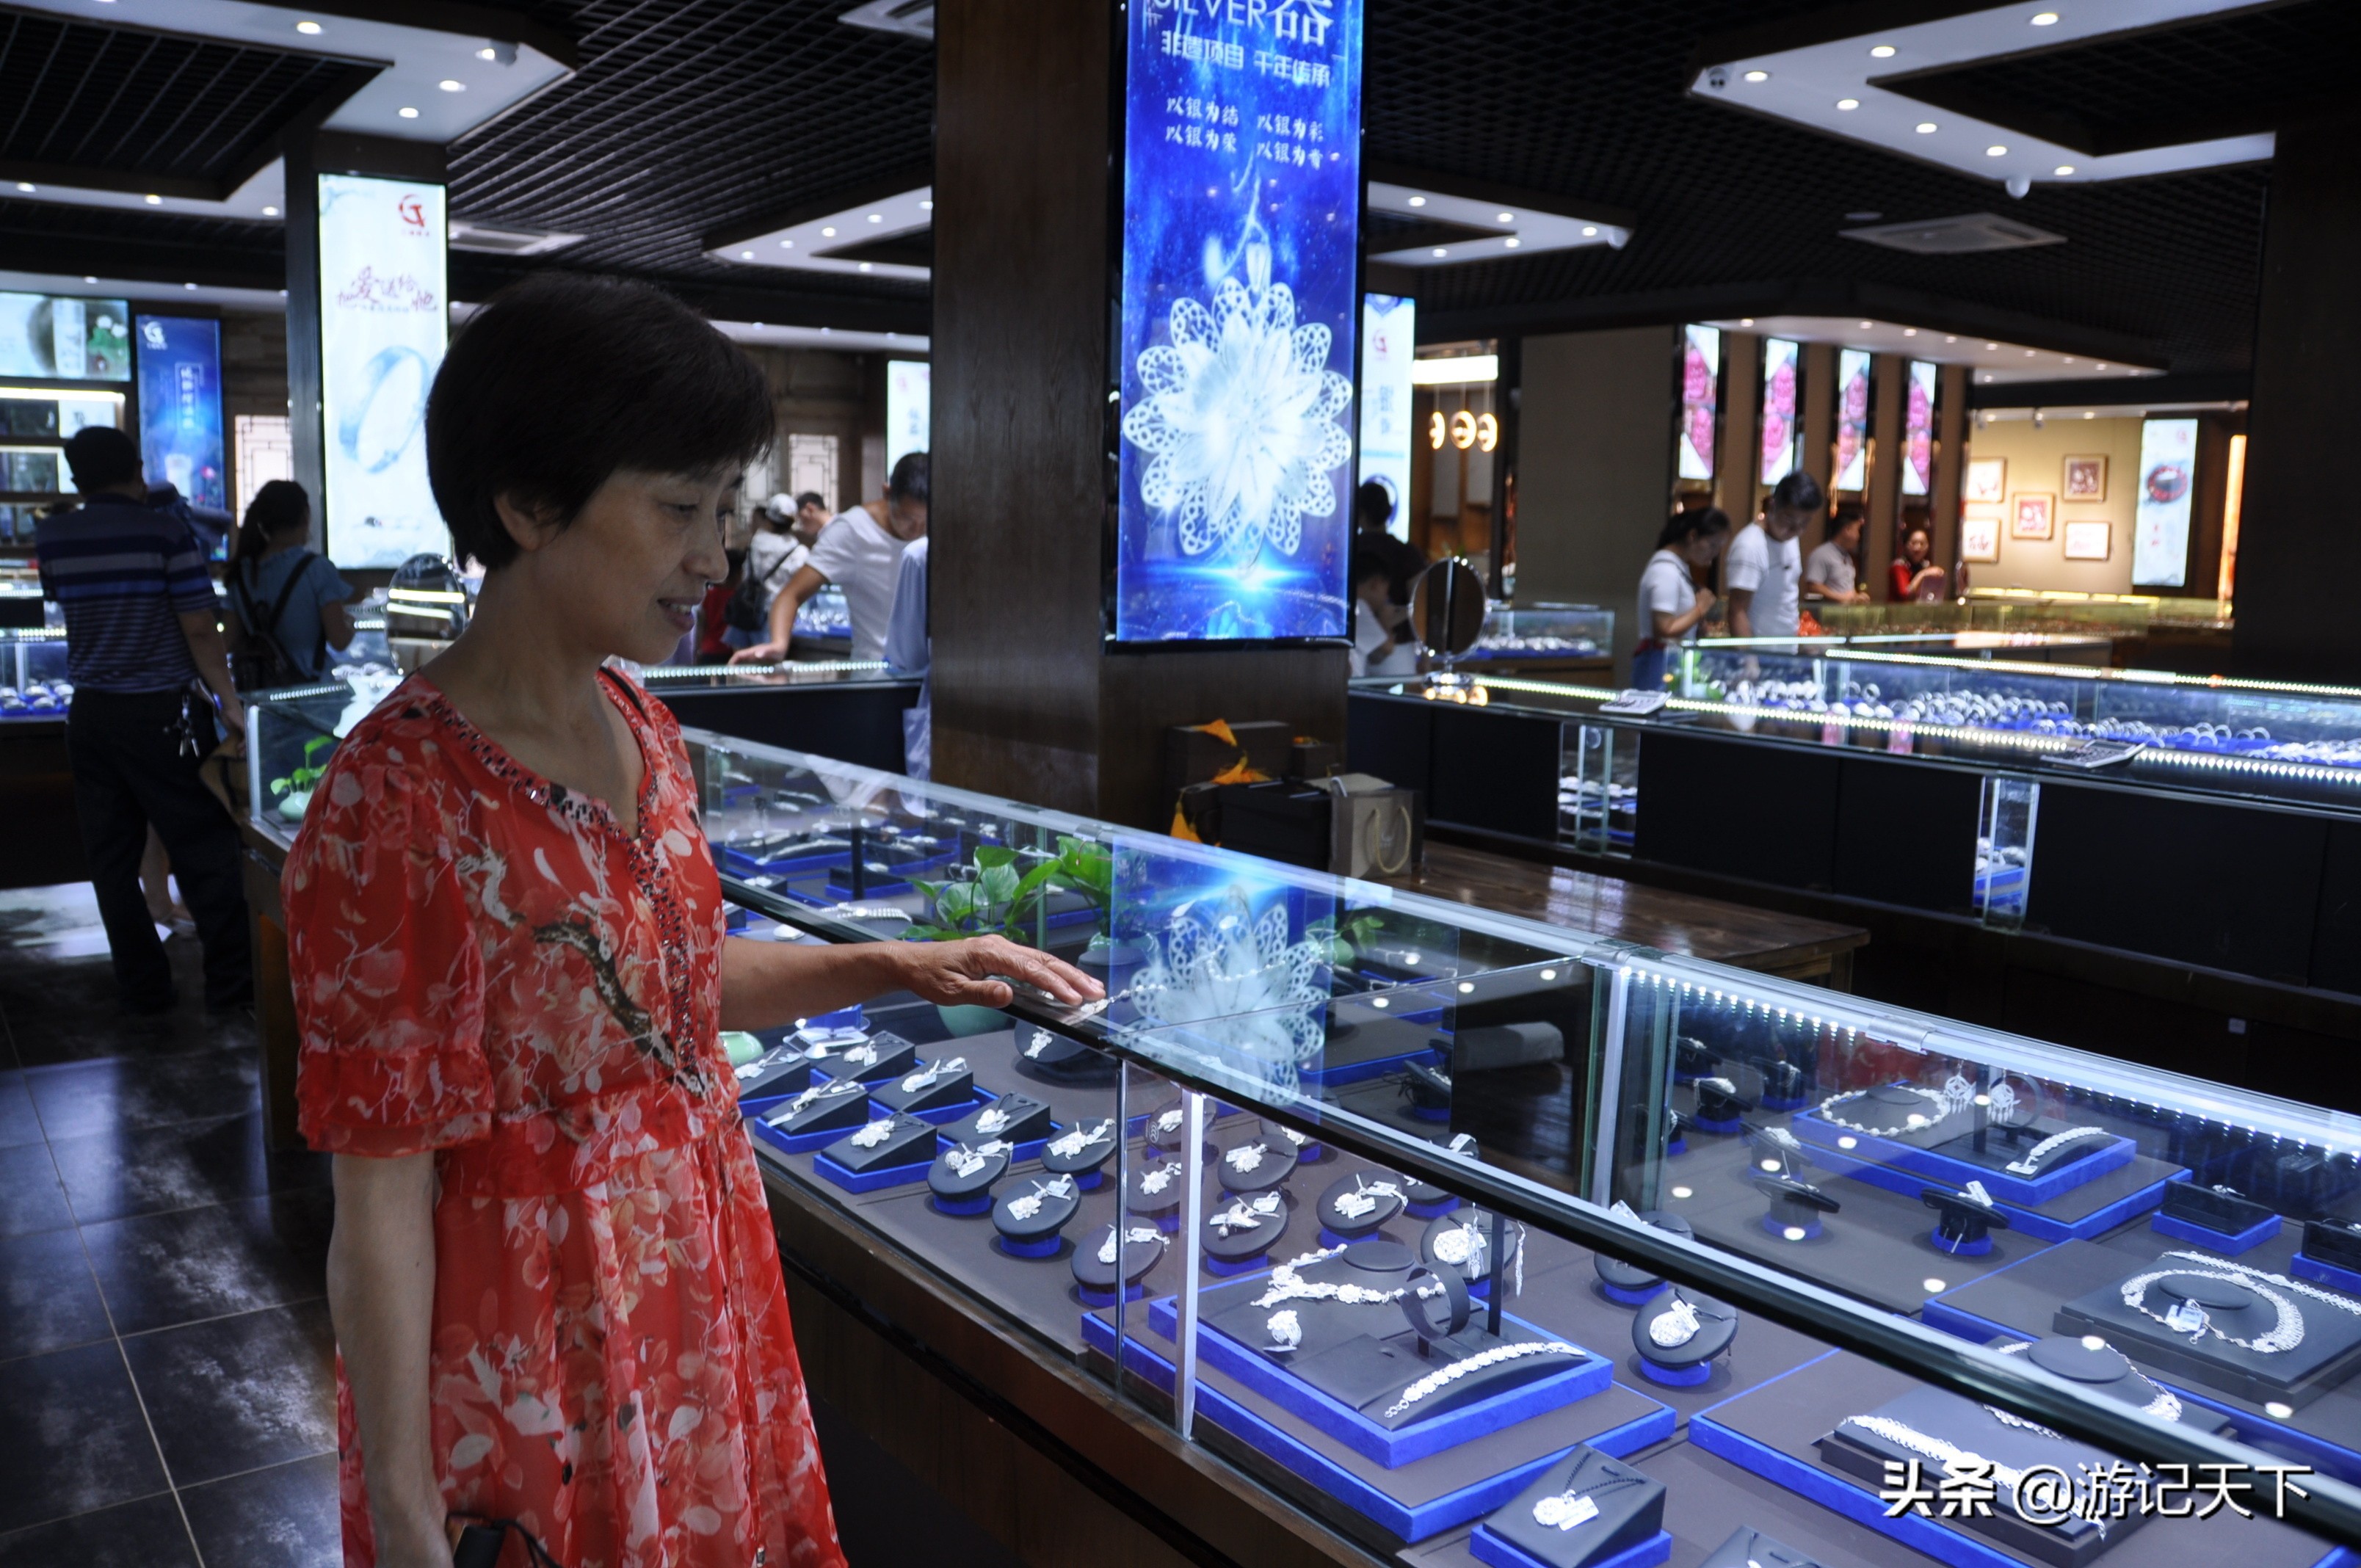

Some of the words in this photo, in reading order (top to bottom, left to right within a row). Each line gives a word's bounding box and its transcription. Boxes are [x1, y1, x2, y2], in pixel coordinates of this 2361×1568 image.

[1161, 30, 1244, 70] 非遗项目
[1253, 50, 1330, 88] 千年传承
[1165, 123, 1237, 153] 以银为荣
[1257, 113, 1324, 143] 以银为彩
